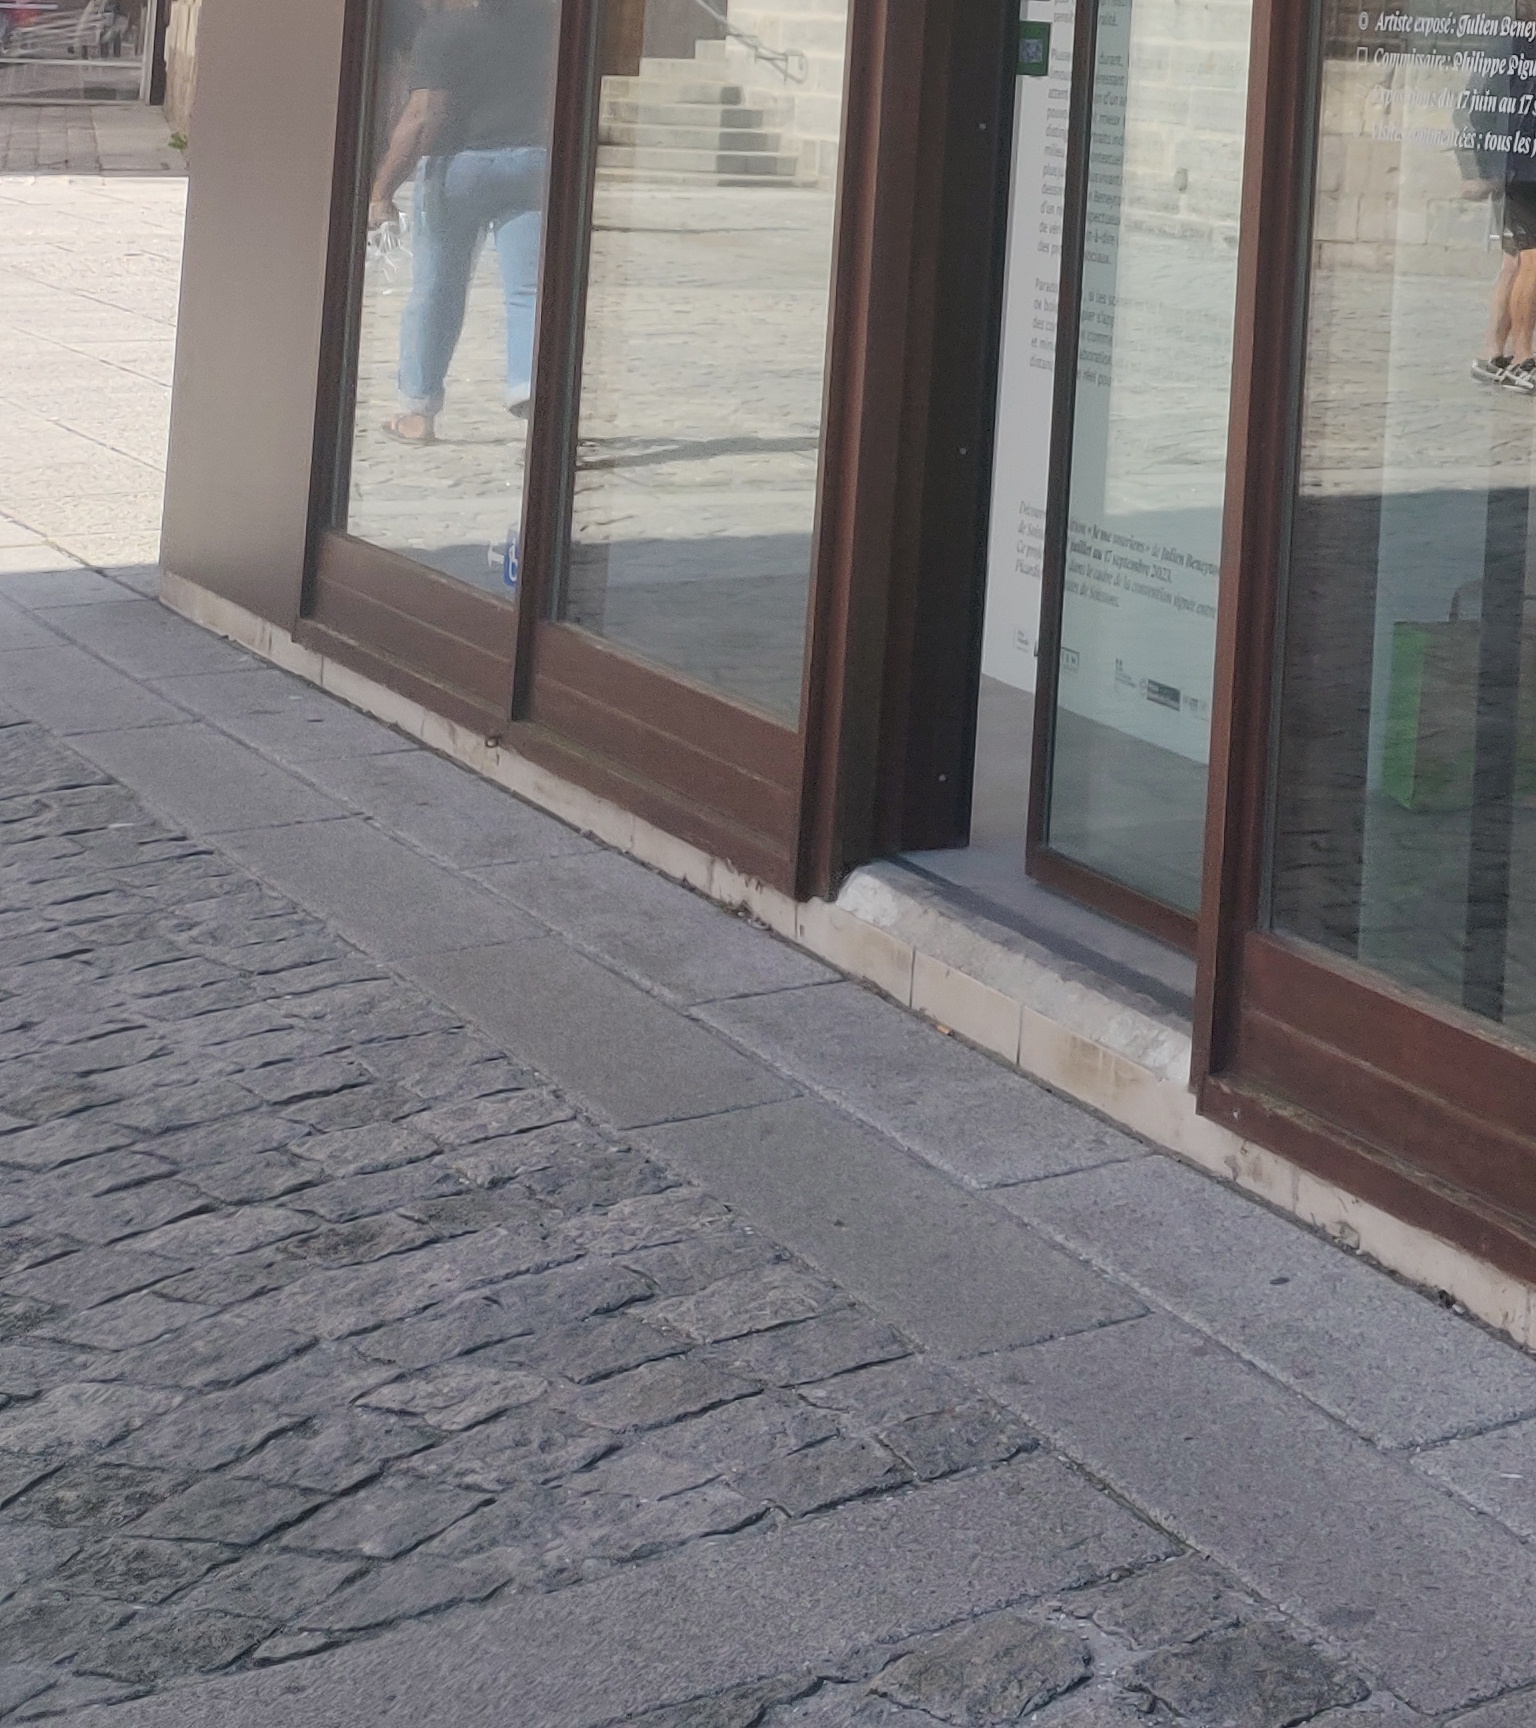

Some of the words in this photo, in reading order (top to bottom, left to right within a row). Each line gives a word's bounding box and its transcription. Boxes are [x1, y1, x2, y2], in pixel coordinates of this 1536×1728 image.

[1374, 10, 1413, 33] Artiste
[1456, 13, 1499, 38] Julien
[1455, 90, 1471, 109] 17
[1468, 89, 1497, 114] juin
[1498, 97, 1516, 114] au
[1518, 94, 1534, 116] 17
[1484, 131, 1511, 154] tous
[1512, 131, 1531, 155] les
